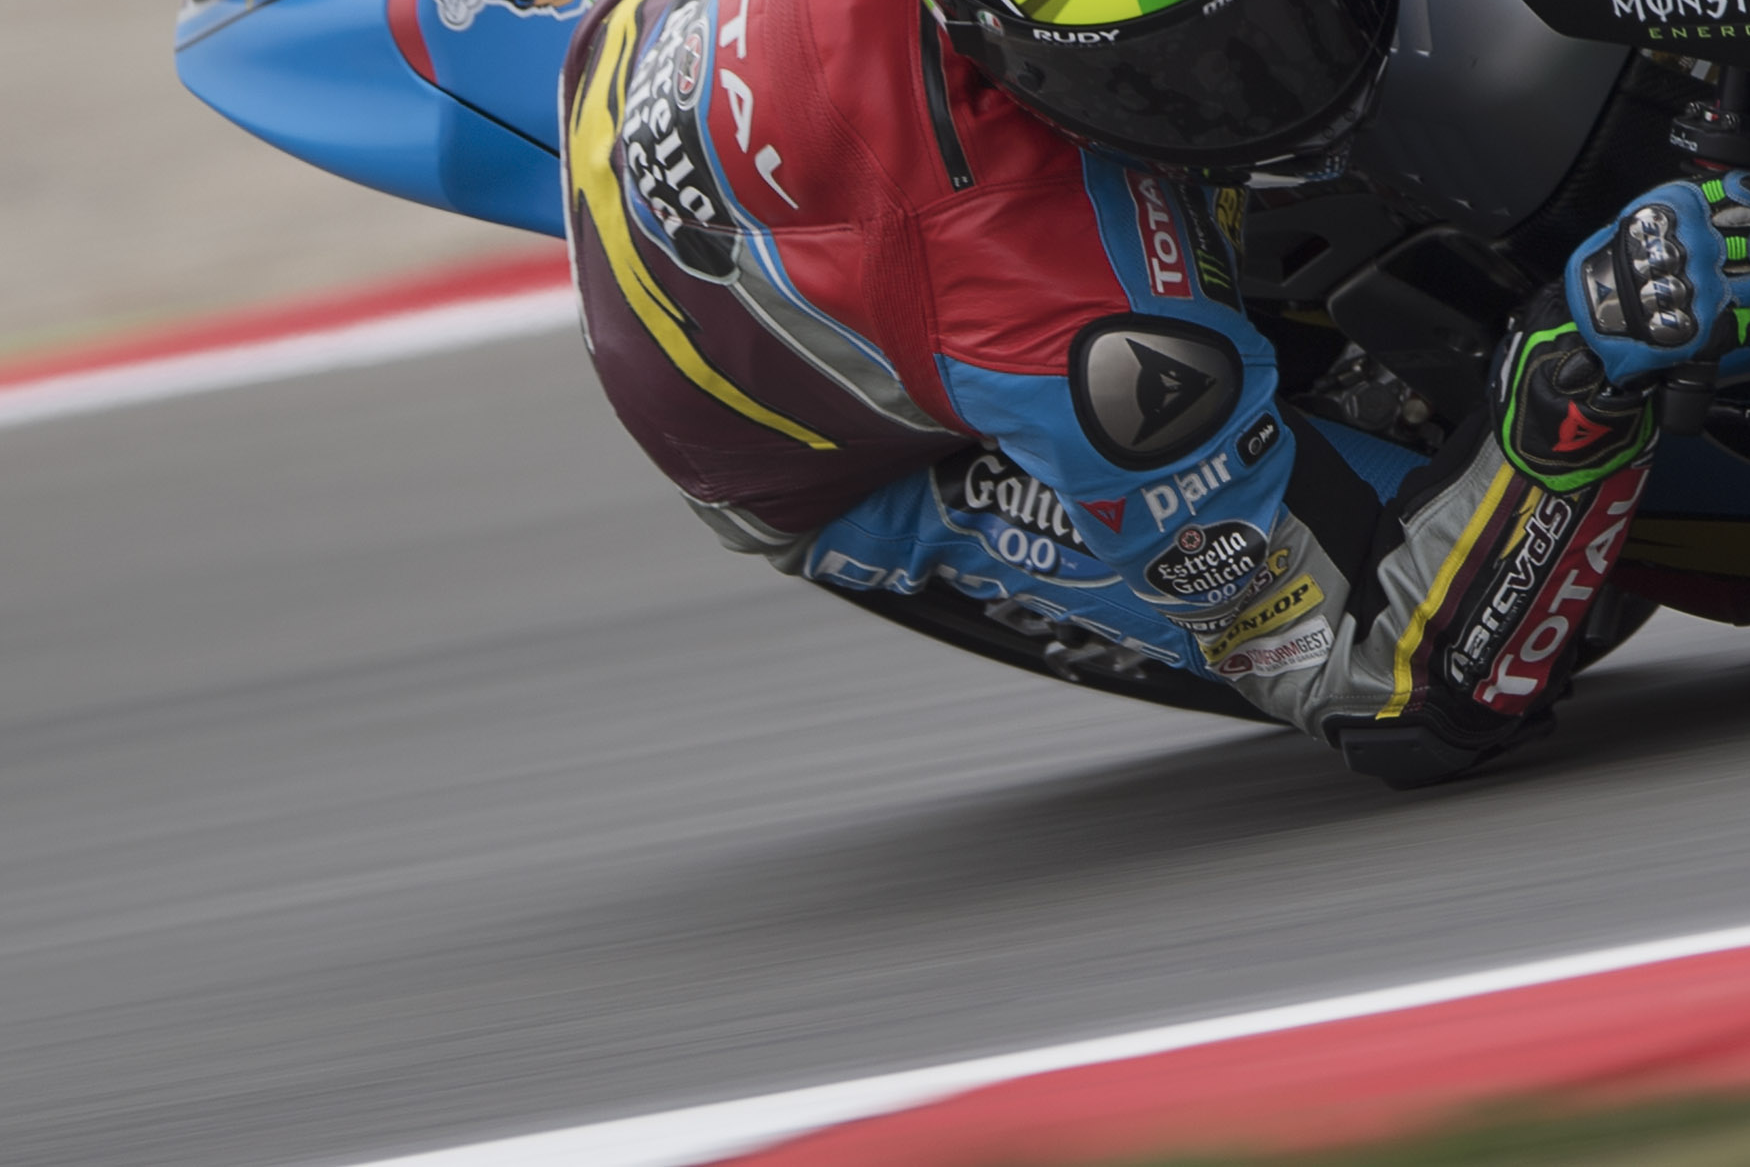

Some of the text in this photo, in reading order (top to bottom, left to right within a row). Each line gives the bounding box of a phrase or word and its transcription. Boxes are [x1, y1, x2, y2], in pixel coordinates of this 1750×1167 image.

[1032, 27, 1121, 45] RUDY
[1139, 178, 1183, 294] TOTA
[1157, 531, 1248, 582] Estrella
[1171, 555, 1255, 596] Galicia
[1482, 468, 1650, 704] TOTAL
[1211, 582, 1311, 657] DUNLOP
